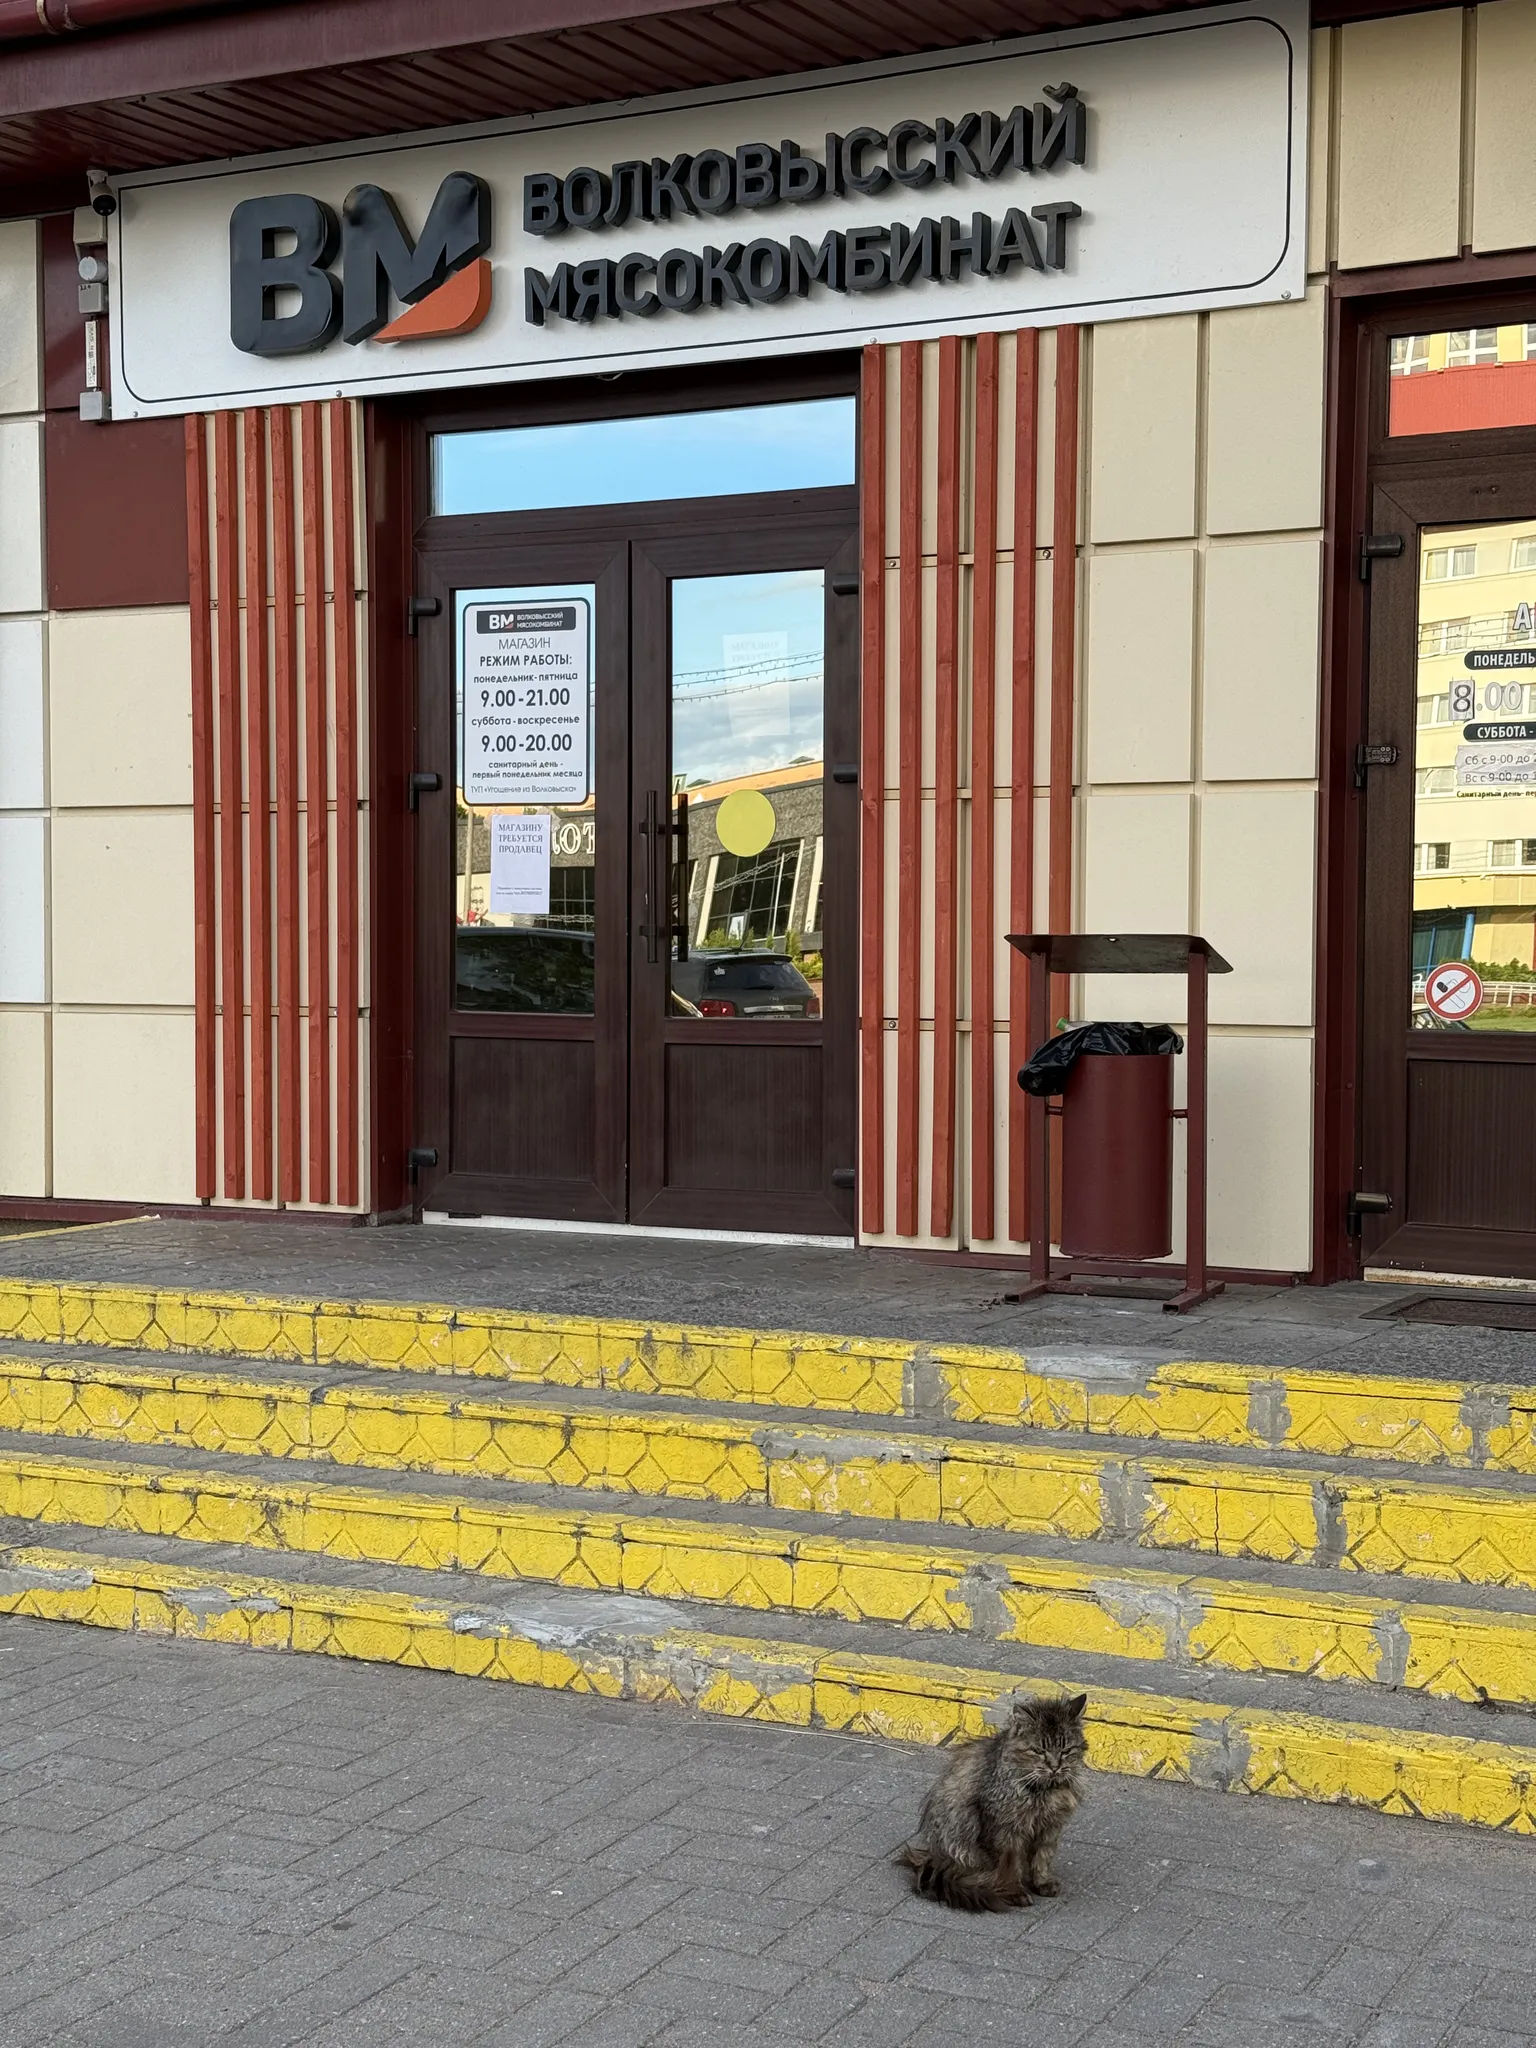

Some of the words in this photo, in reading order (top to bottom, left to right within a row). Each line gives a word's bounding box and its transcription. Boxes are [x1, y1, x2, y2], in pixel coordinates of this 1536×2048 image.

[523, 81, 1087, 236] ВОЛКОВЫССКИЙ
[524, 201, 1082, 326] МЯСОКОМБИНАТ
[516, 611, 564, 621] ВОЛКОВЫССКИЙ
[516, 621, 563, 629] МЯСОКОМБИНАТ
[498, 637, 551, 650] МАГАЗИН
[479, 655, 520, 667] РЕЖИМ
[523, 654, 573, 666] РАБОТЫ:
[1477, 725, 1527, 739] СУББОТА
[488, 760, 538, 769] санитарный
[539, 760, 559, 769] день
[1464, 755, 1479, 765] Сб
[1481, 757, 1488, 765] с
[1490, 754, 1514, 764] 9-00
[1515, 755, 1530, 764] до
[472, 770, 500, 780] первый
[502, 770, 552, 778] понедельник
[552, 770, 583, 778] месяца
[1465, 774, 1478, 783] Вс
[1488, 772, 1512, 782] 9-00
[1514, 773, 1529, 783] до
[498, 823, 544, 832] МАГАЗИНУ
[498, 834, 544, 843] ТРЕБУЕТСЯ
[498, 845, 544, 855] ПРОДАВЕЦ
